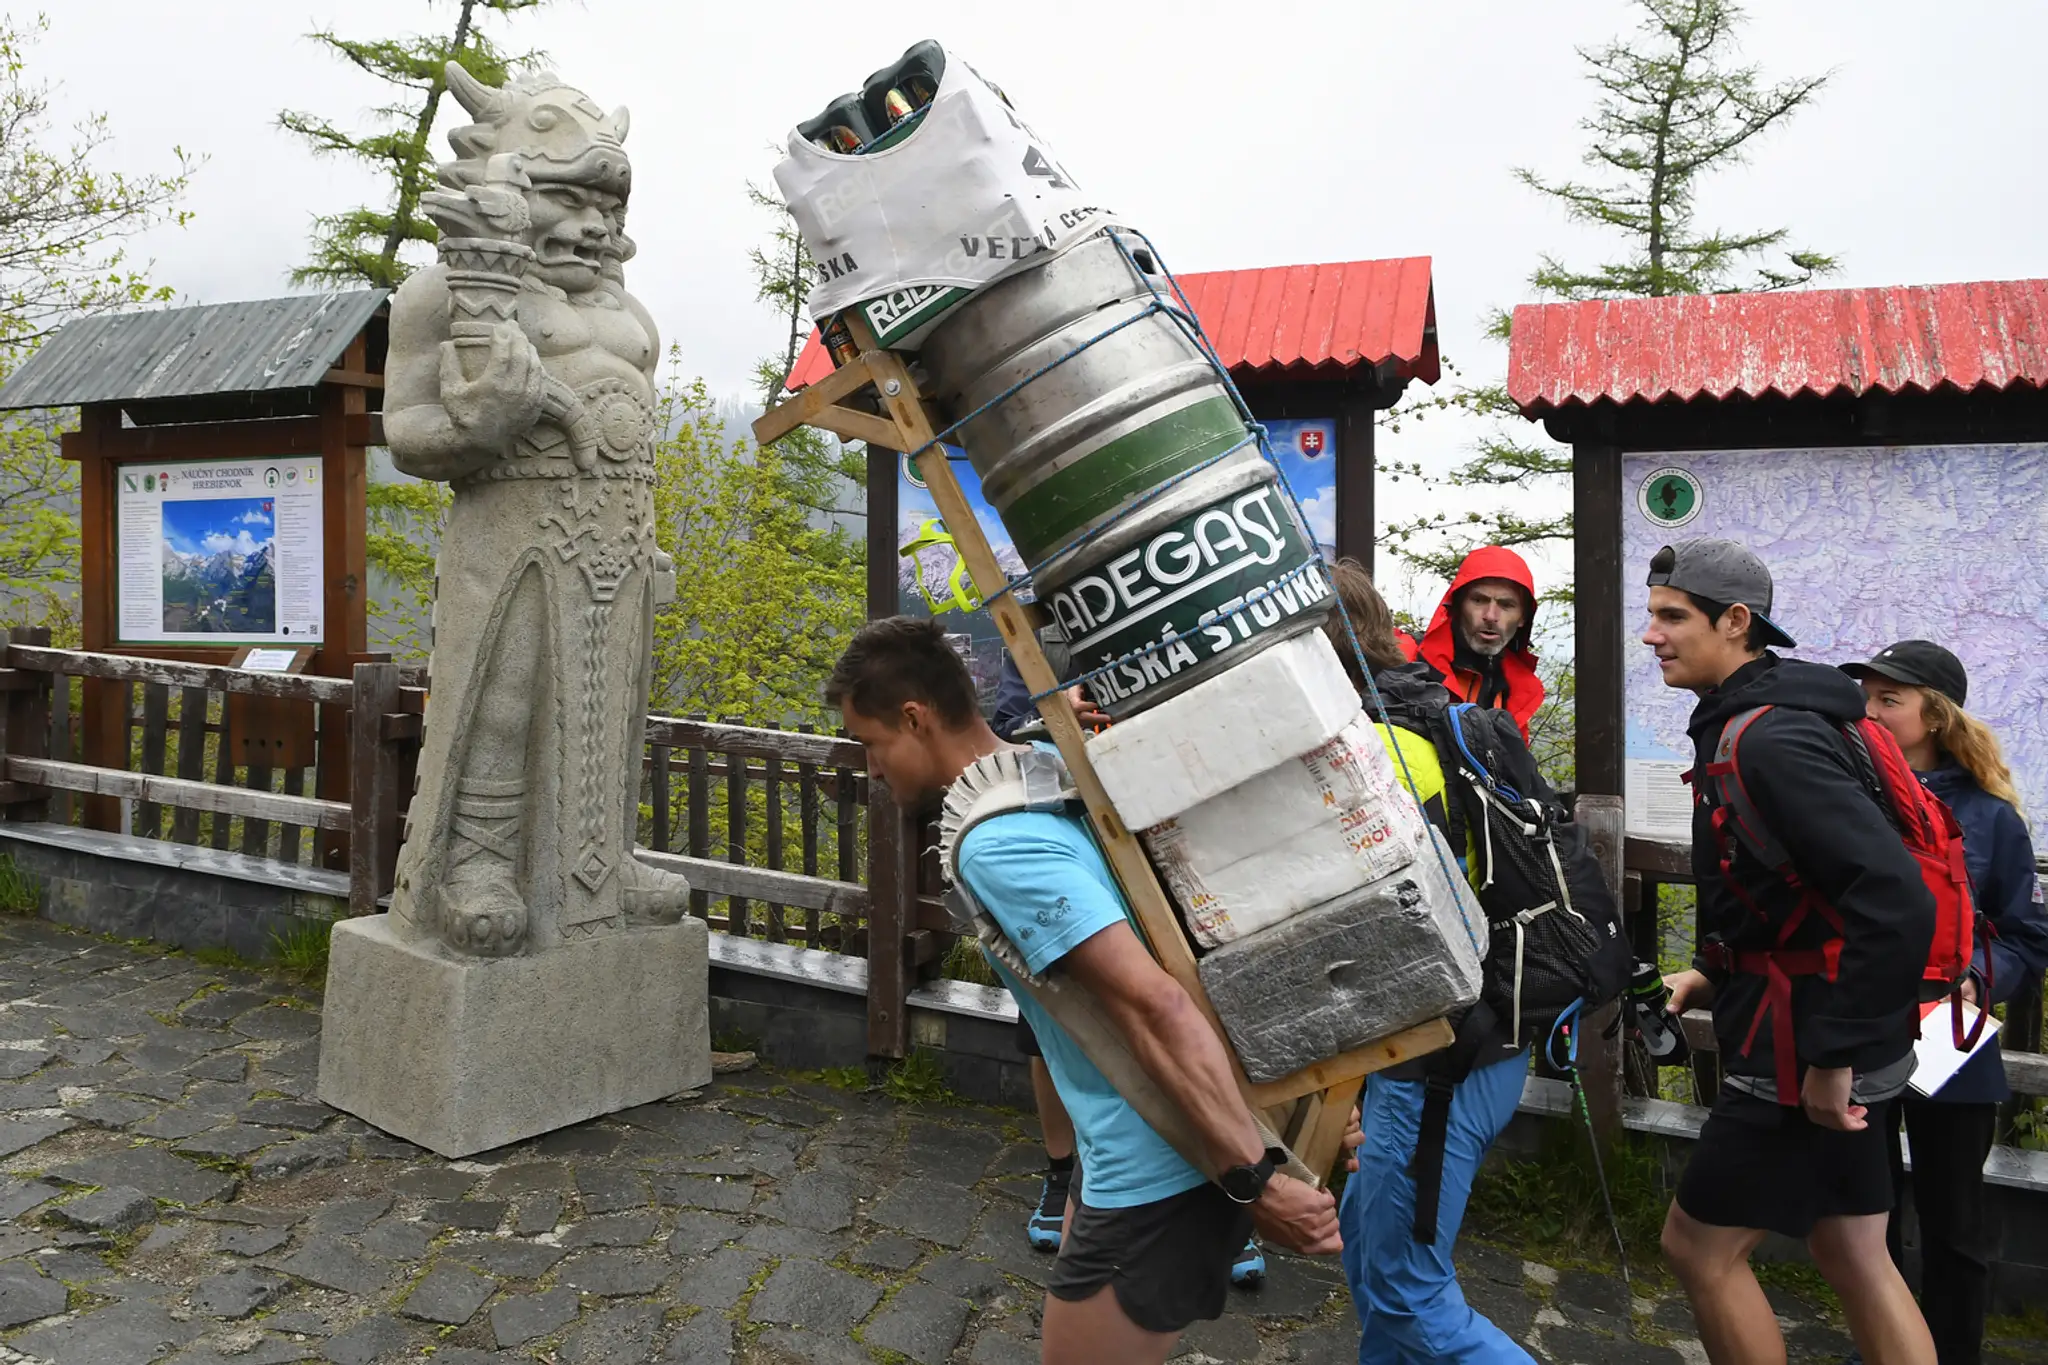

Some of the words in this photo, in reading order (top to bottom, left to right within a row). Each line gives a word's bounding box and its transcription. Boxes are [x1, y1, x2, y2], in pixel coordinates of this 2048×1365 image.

[1059, 206, 1118, 229] CEN
[817, 252, 858, 284] SKA
[865, 286, 952, 338] RAD
[1085, 621, 1198, 709] SIČSKÁ
[1198, 565, 1330, 653] STOVKA
